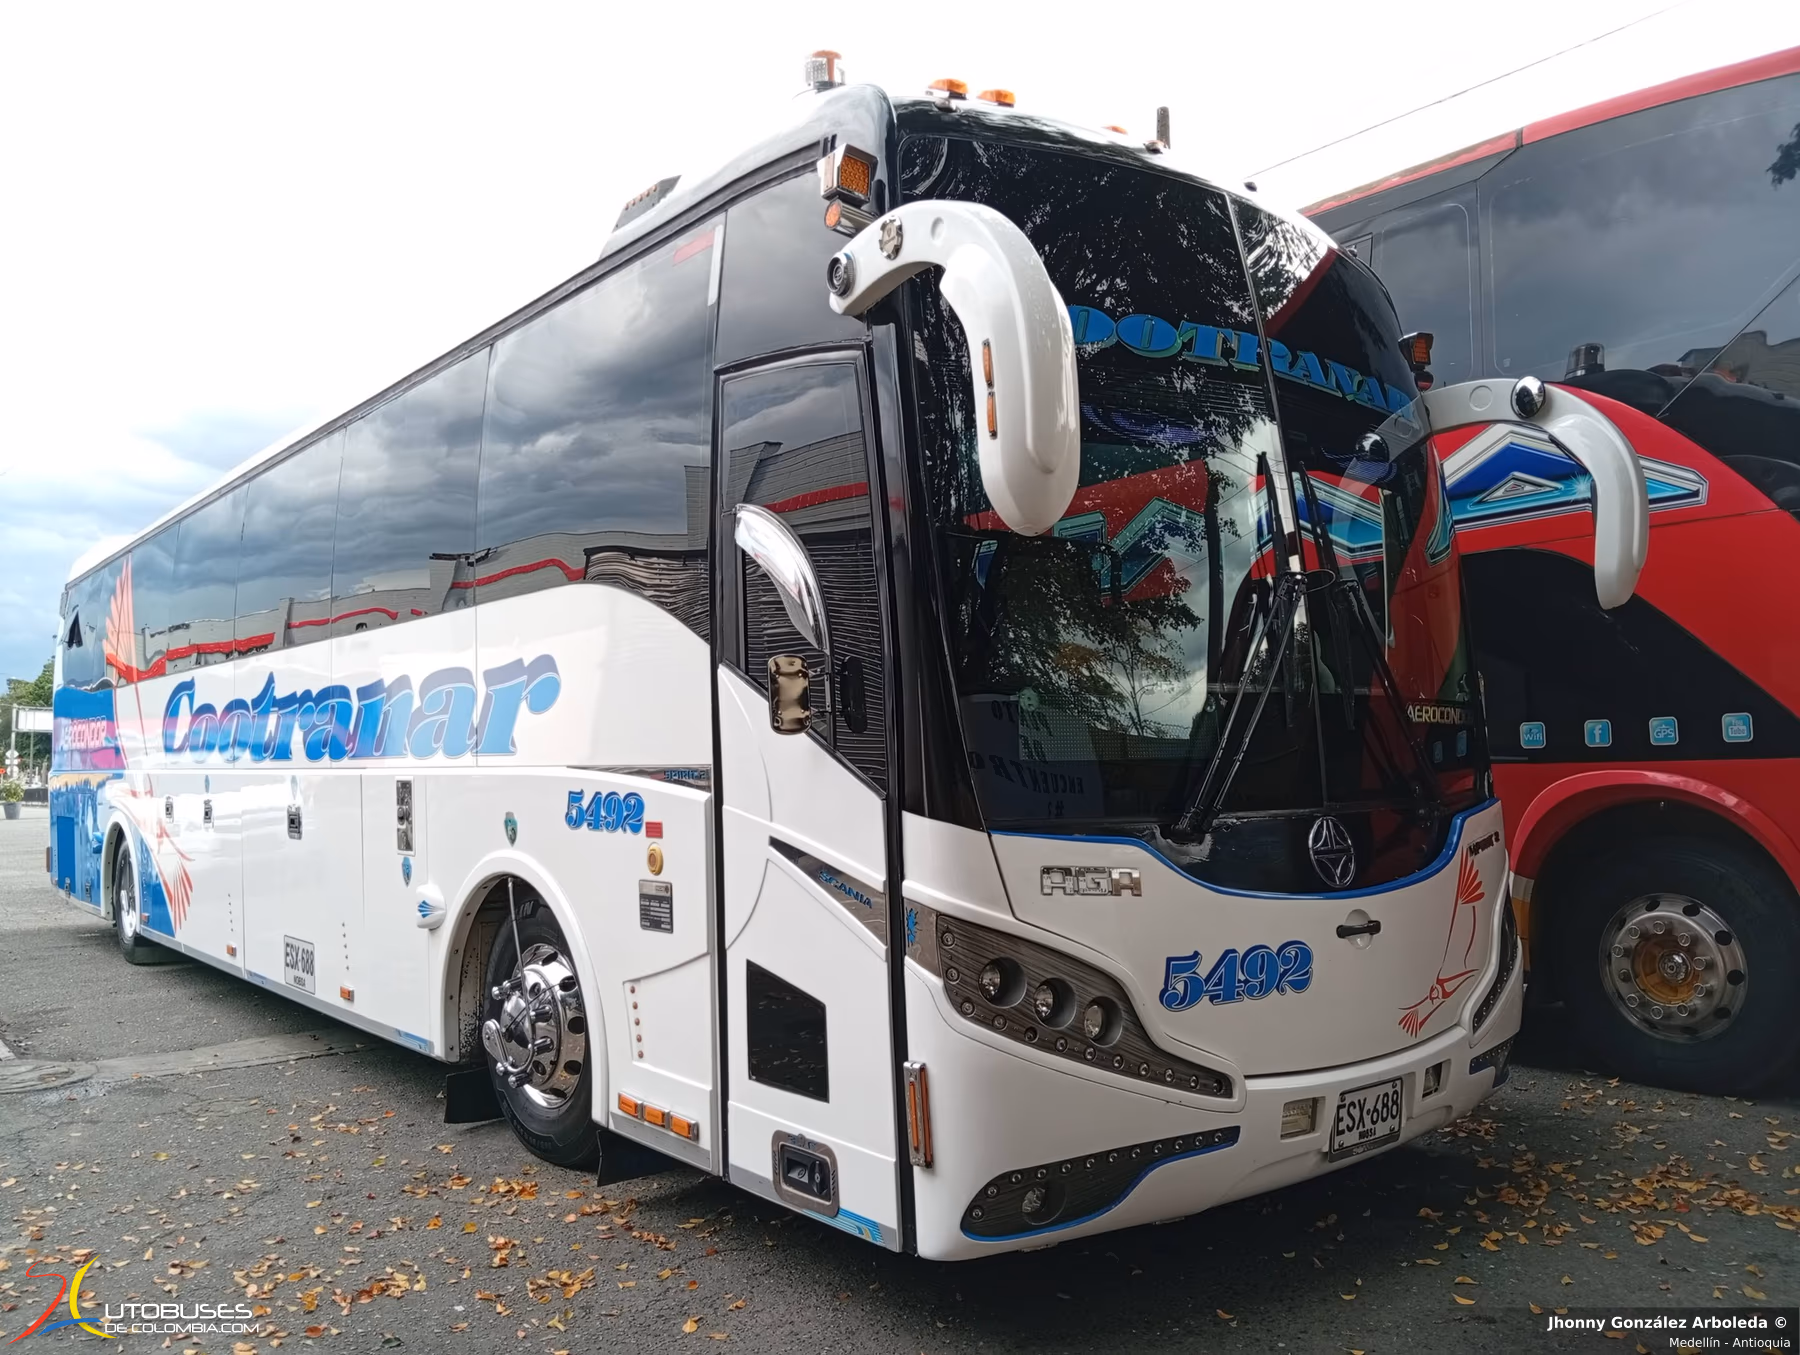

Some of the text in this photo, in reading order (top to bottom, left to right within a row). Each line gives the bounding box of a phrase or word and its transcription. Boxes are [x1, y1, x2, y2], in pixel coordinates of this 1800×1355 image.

[1066, 304, 1415, 423] OOTRANAR
[162, 653, 562, 763] Cootranar
[1653, 728, 1675, 738] GPS
[565, 788, 645, 835] 5492
[818, 868, 873, 909] SCANIA
[1041, 866, 1142, 896] AGA
[1159, 940, 1314, 1012] 5492
